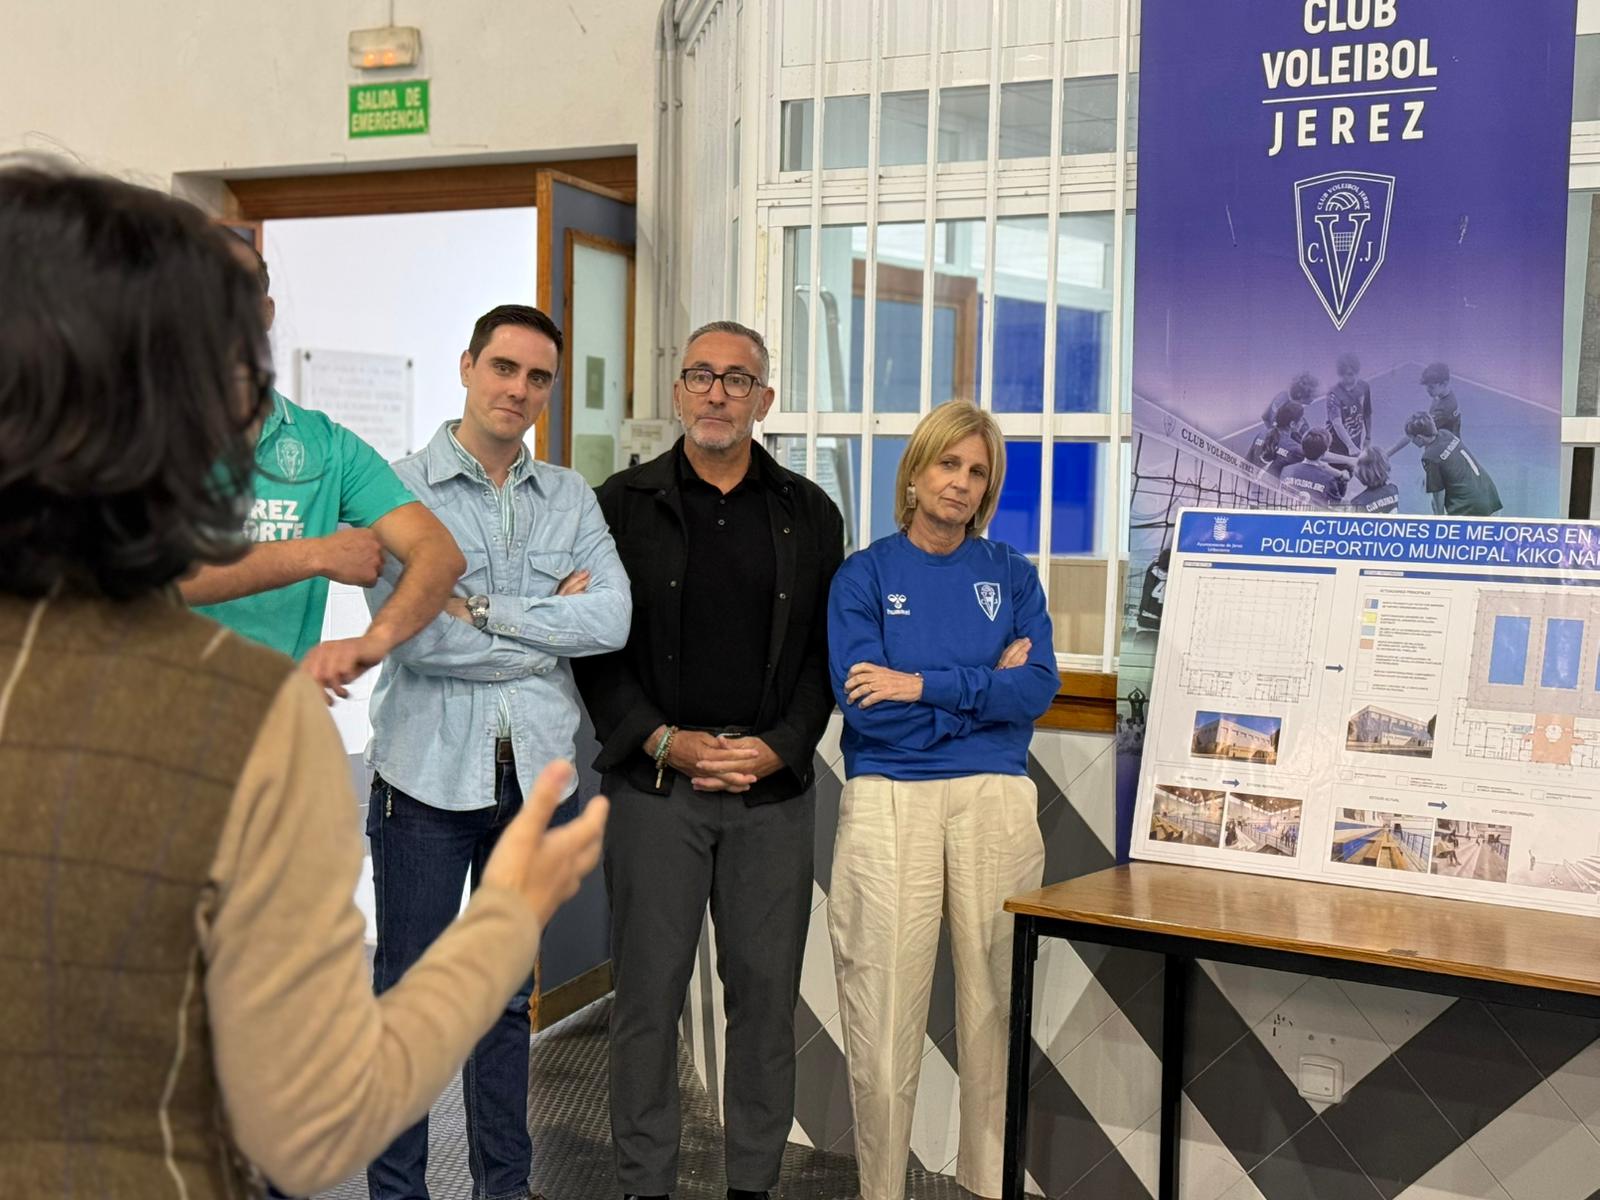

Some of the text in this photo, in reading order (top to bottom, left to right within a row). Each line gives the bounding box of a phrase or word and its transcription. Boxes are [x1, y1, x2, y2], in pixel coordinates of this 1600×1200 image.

[1304, 0, 1397, 34] CLUB
[1262, 38, 1438, 89] VOLEIBOL
[357, 86, 421, 110] SALIDA DE
[352, 109, 426, 132] EMERGENCIA
[1268, 101, 1425, 156] JEREZ
[1316, 183, 1371, 210] CLUB VOLEIBOL JEREZ
[1181, 428, 1205, 449] CLUB
[1206, 442, 1238, 466] VOLEIBOL
[250, 498, 299, 521] REZ
[242, 521, 305, 542] ORTE
[1301, 519, 1592, 546] ACTUACIONES DE MEJORAS EN
[1260, 537, 1600, 566] POLIDEPORTIVO MUNICIPAL KIKO NA
